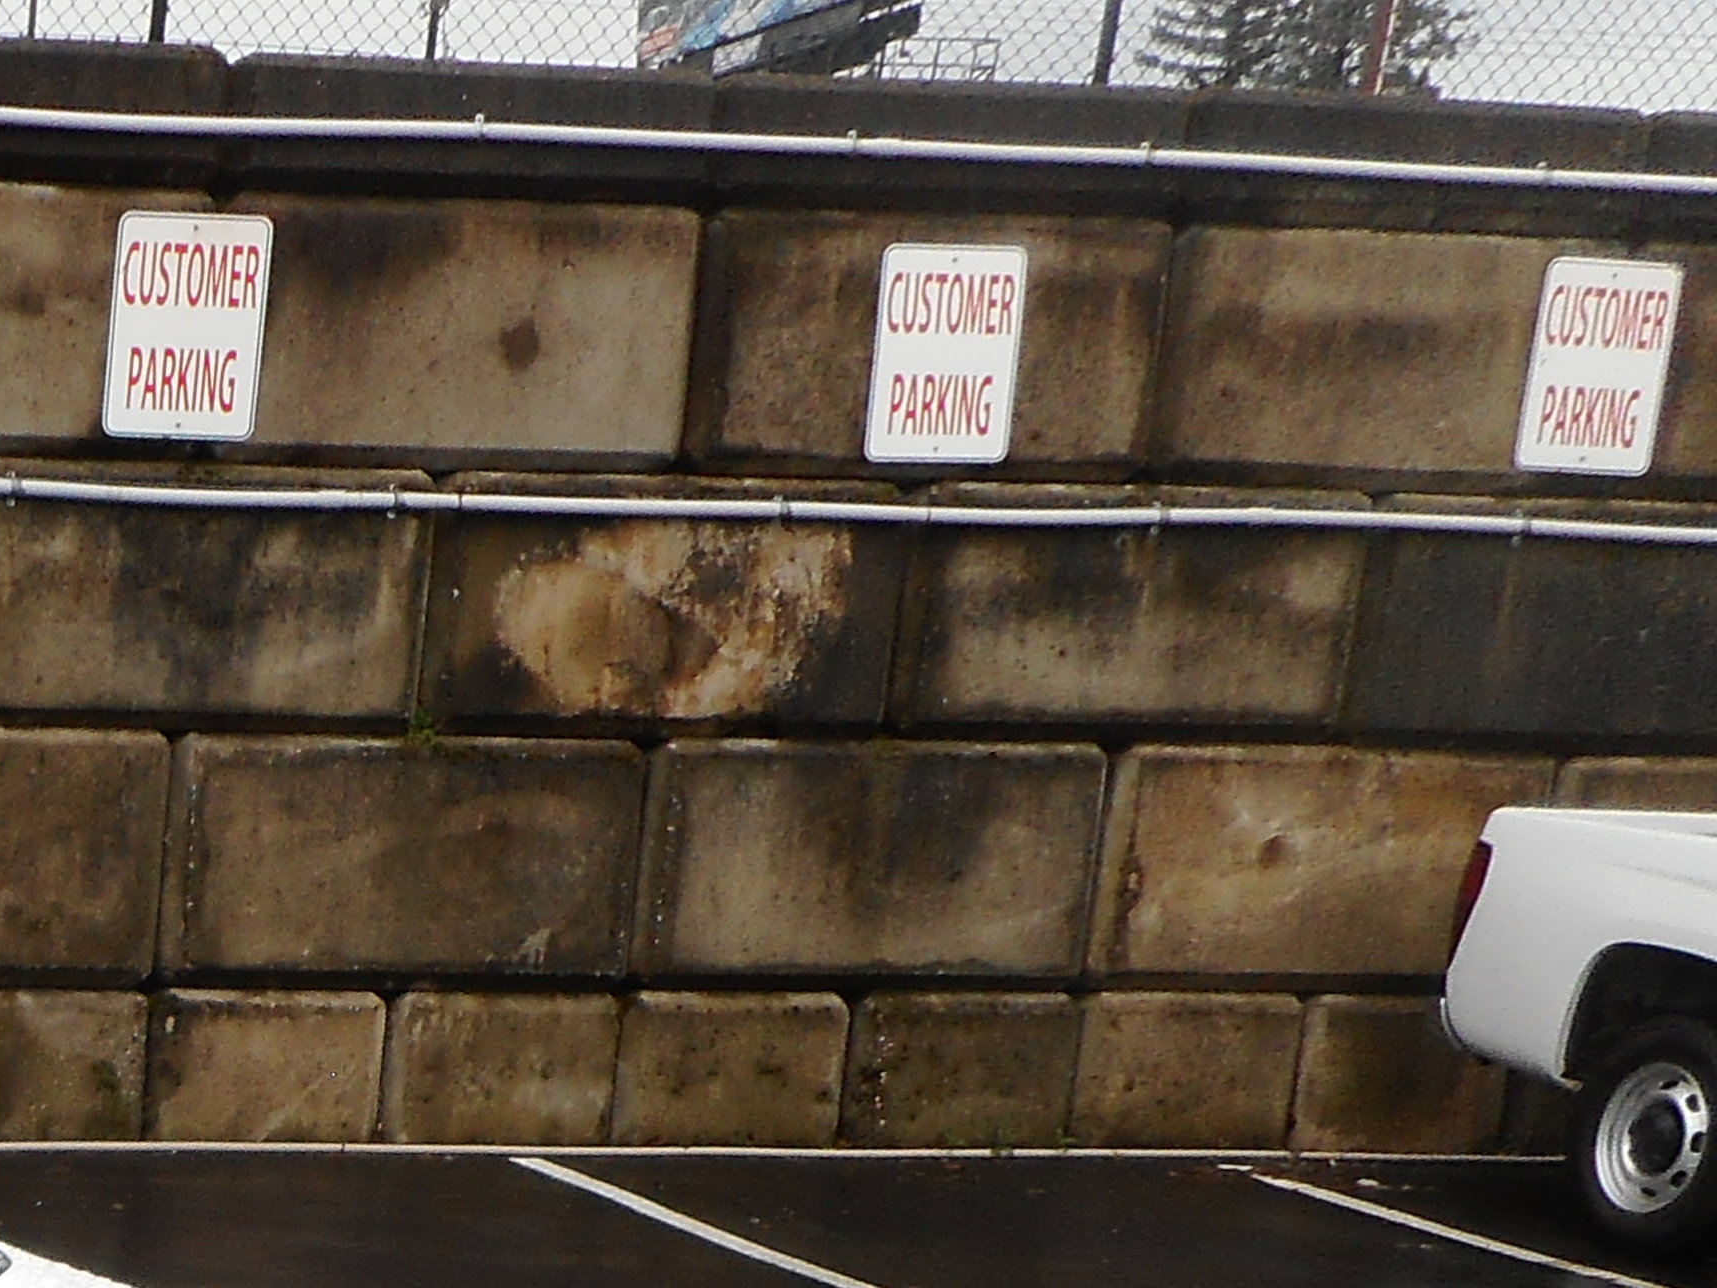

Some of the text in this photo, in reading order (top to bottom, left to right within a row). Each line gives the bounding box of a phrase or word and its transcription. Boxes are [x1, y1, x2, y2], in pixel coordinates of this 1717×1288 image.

[122, 240, 262, 310] CUSTOMER
[886, 271, 1014, 337] CUSTOMER
[1544, 285, 1671, 352] CUSTOMER
[125, 346, 239, 415] PARKING
[886, 373, 995, 437] PARKING
[1536, 386, 1642, 449] PARKING
